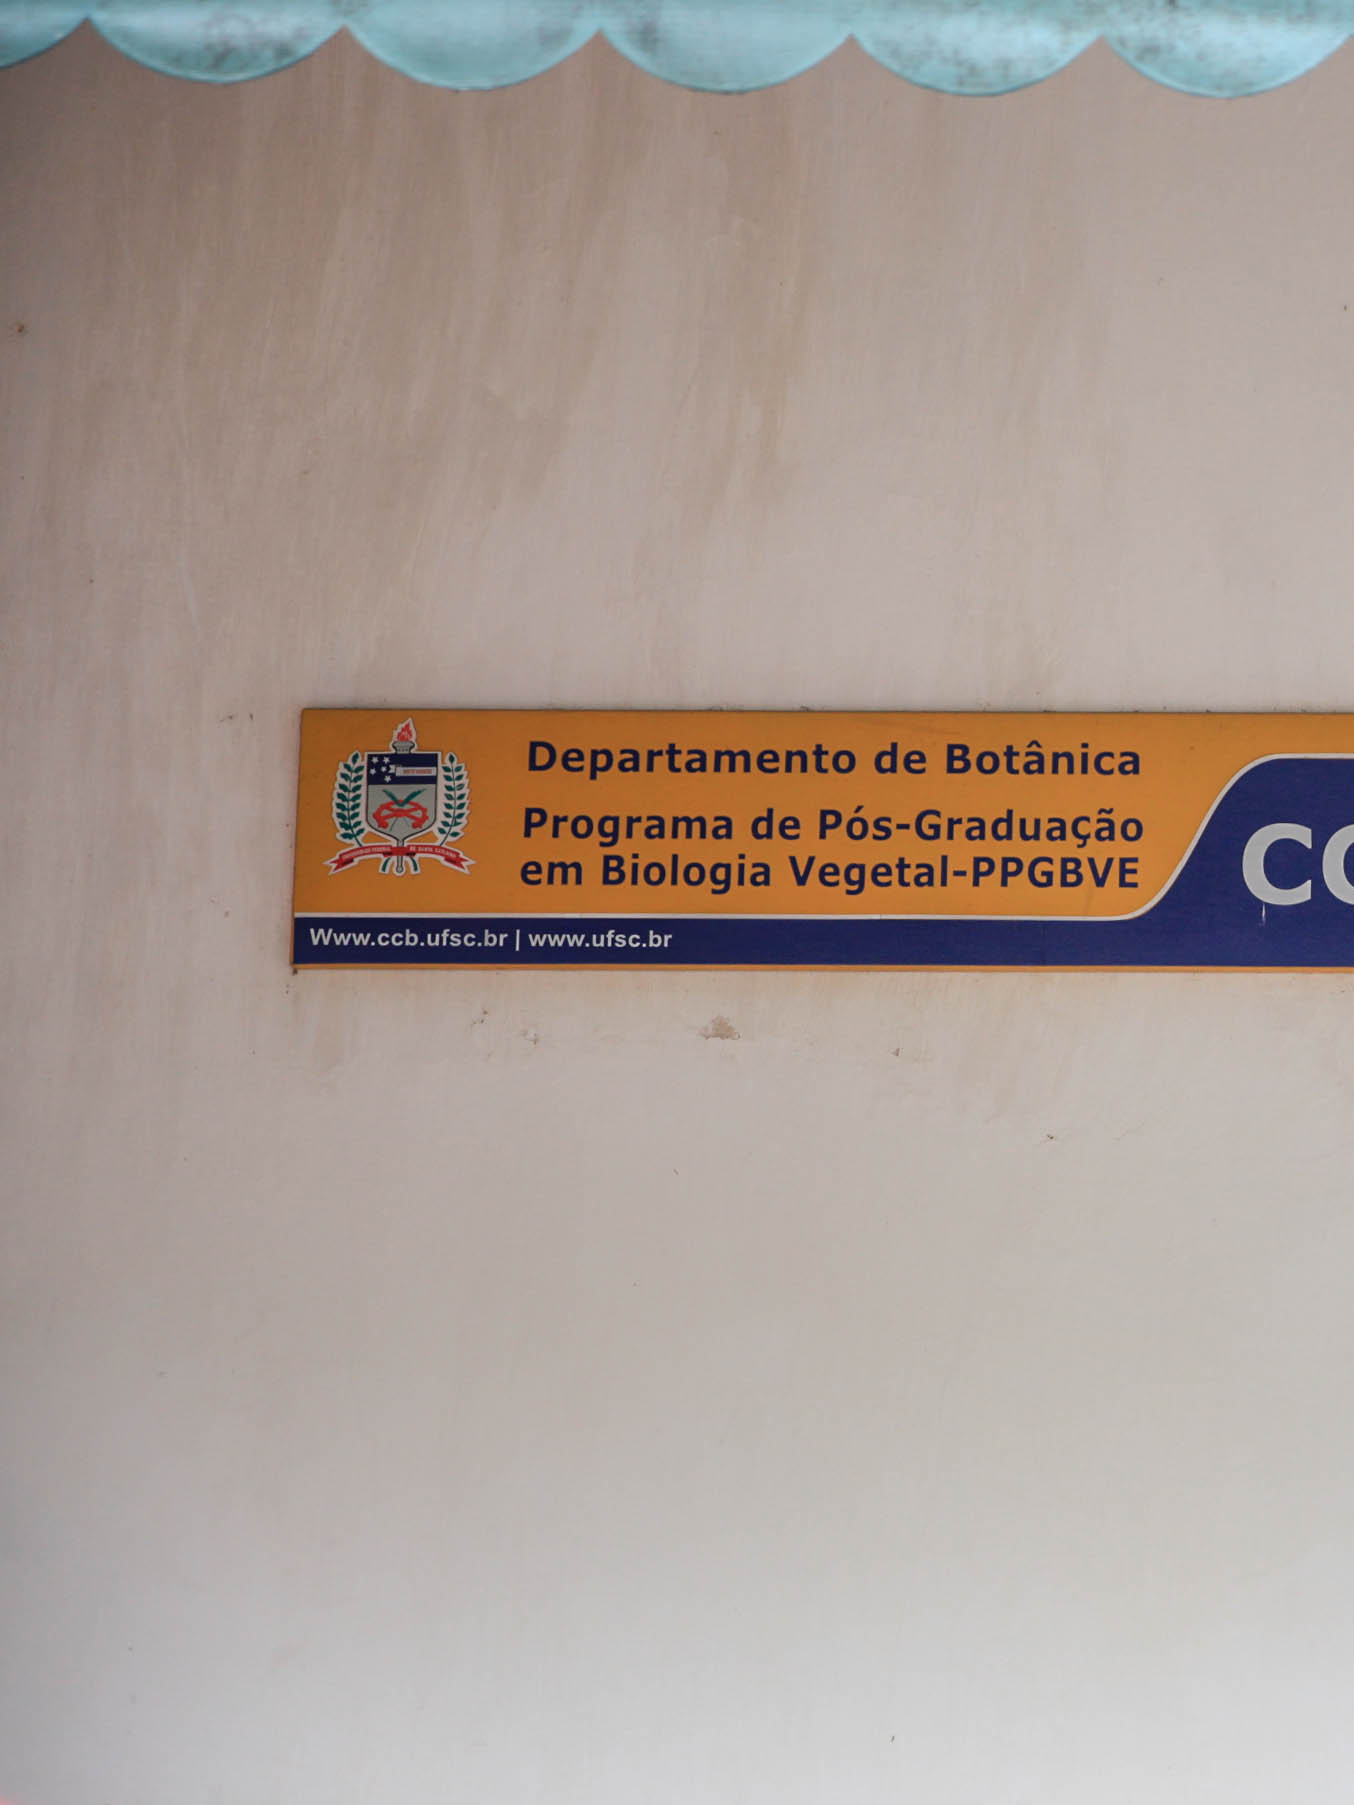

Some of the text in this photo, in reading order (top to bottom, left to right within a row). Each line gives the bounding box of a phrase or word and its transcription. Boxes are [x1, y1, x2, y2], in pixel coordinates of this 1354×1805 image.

[528, 740, 1141, 780] Departamento de Botânica
[523, 805, 1144, 849] Programa de Pós-Graduação
[520, 853, 1139, 896] em Biologia Vegetal-PPGBVE
[309, 927, 509, 947] Www.ccb.ufsc.br
[528, 929, 673, 948] www.ufsc.br
